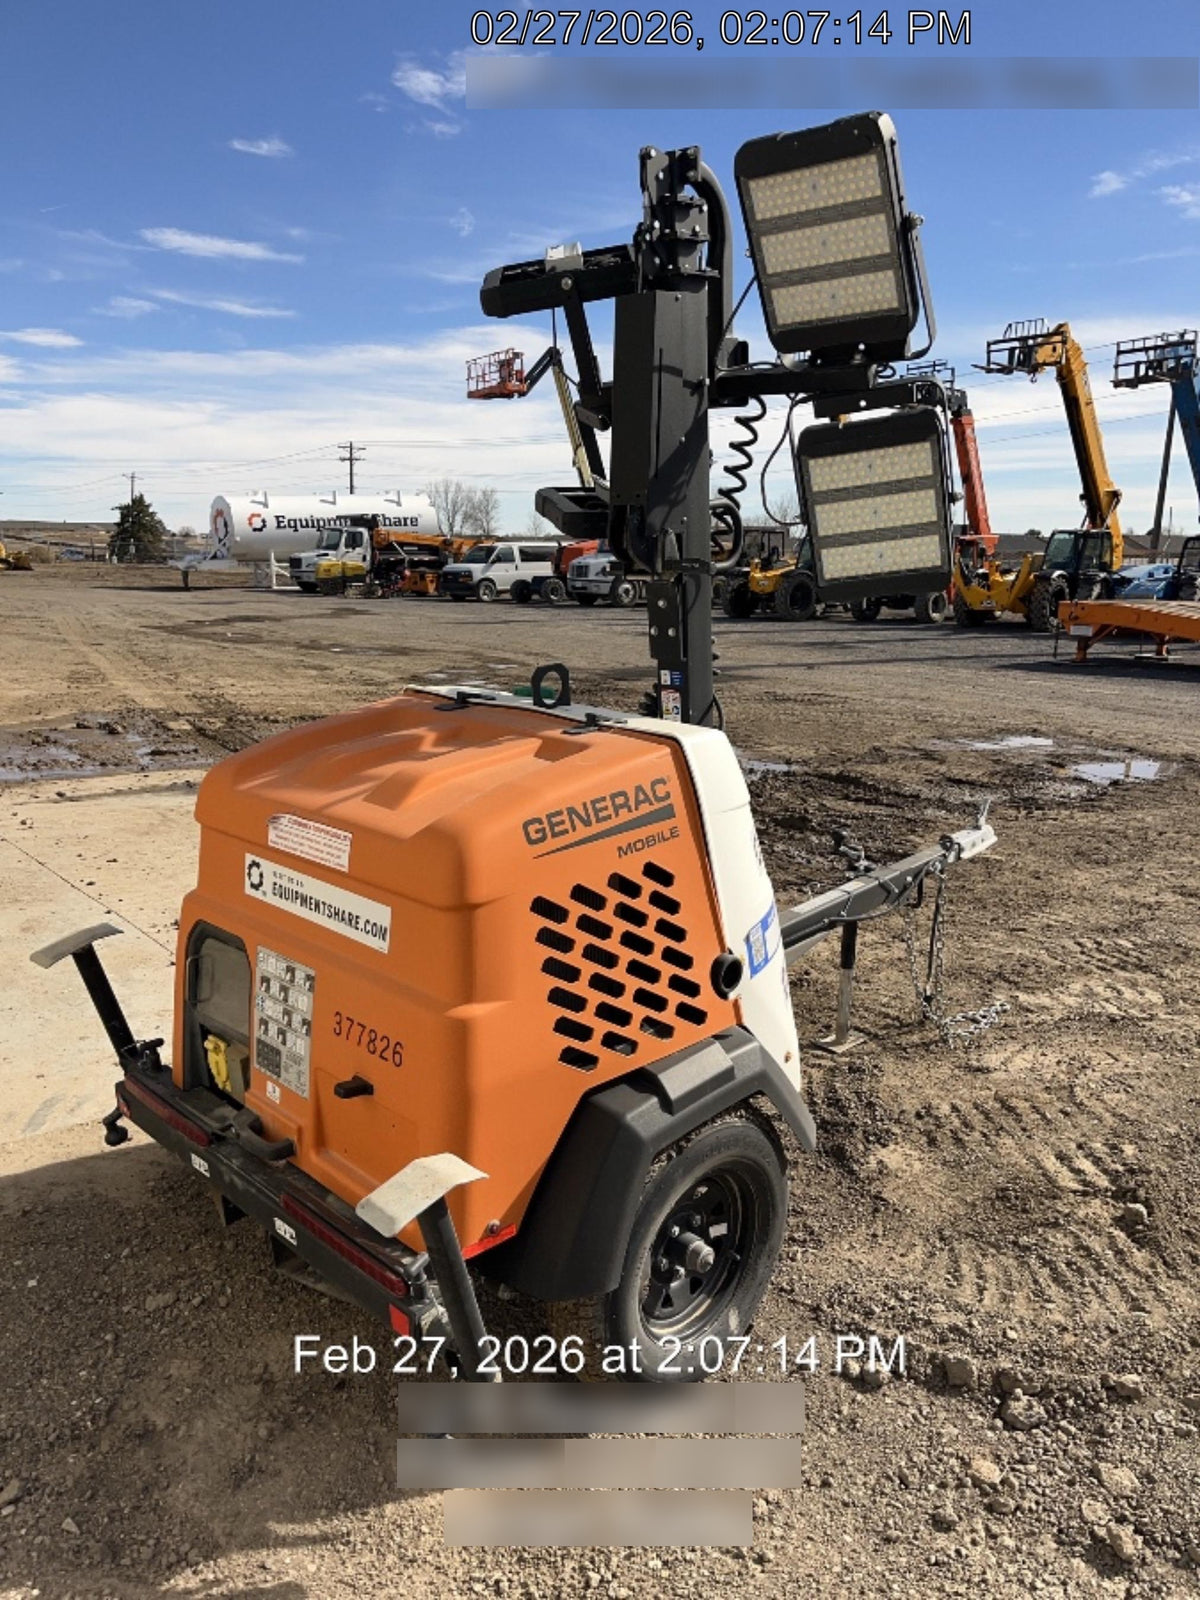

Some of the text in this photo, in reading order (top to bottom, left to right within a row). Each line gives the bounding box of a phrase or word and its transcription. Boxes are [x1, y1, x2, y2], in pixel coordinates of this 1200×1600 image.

[522, 777, 671, 846] GENERAC
[616, 826, 680, 859] MOBILE
[271, 881, 389, 942] EQUIPMENTSHARE.COM
[333, 1011, 404, 1067] 377826
